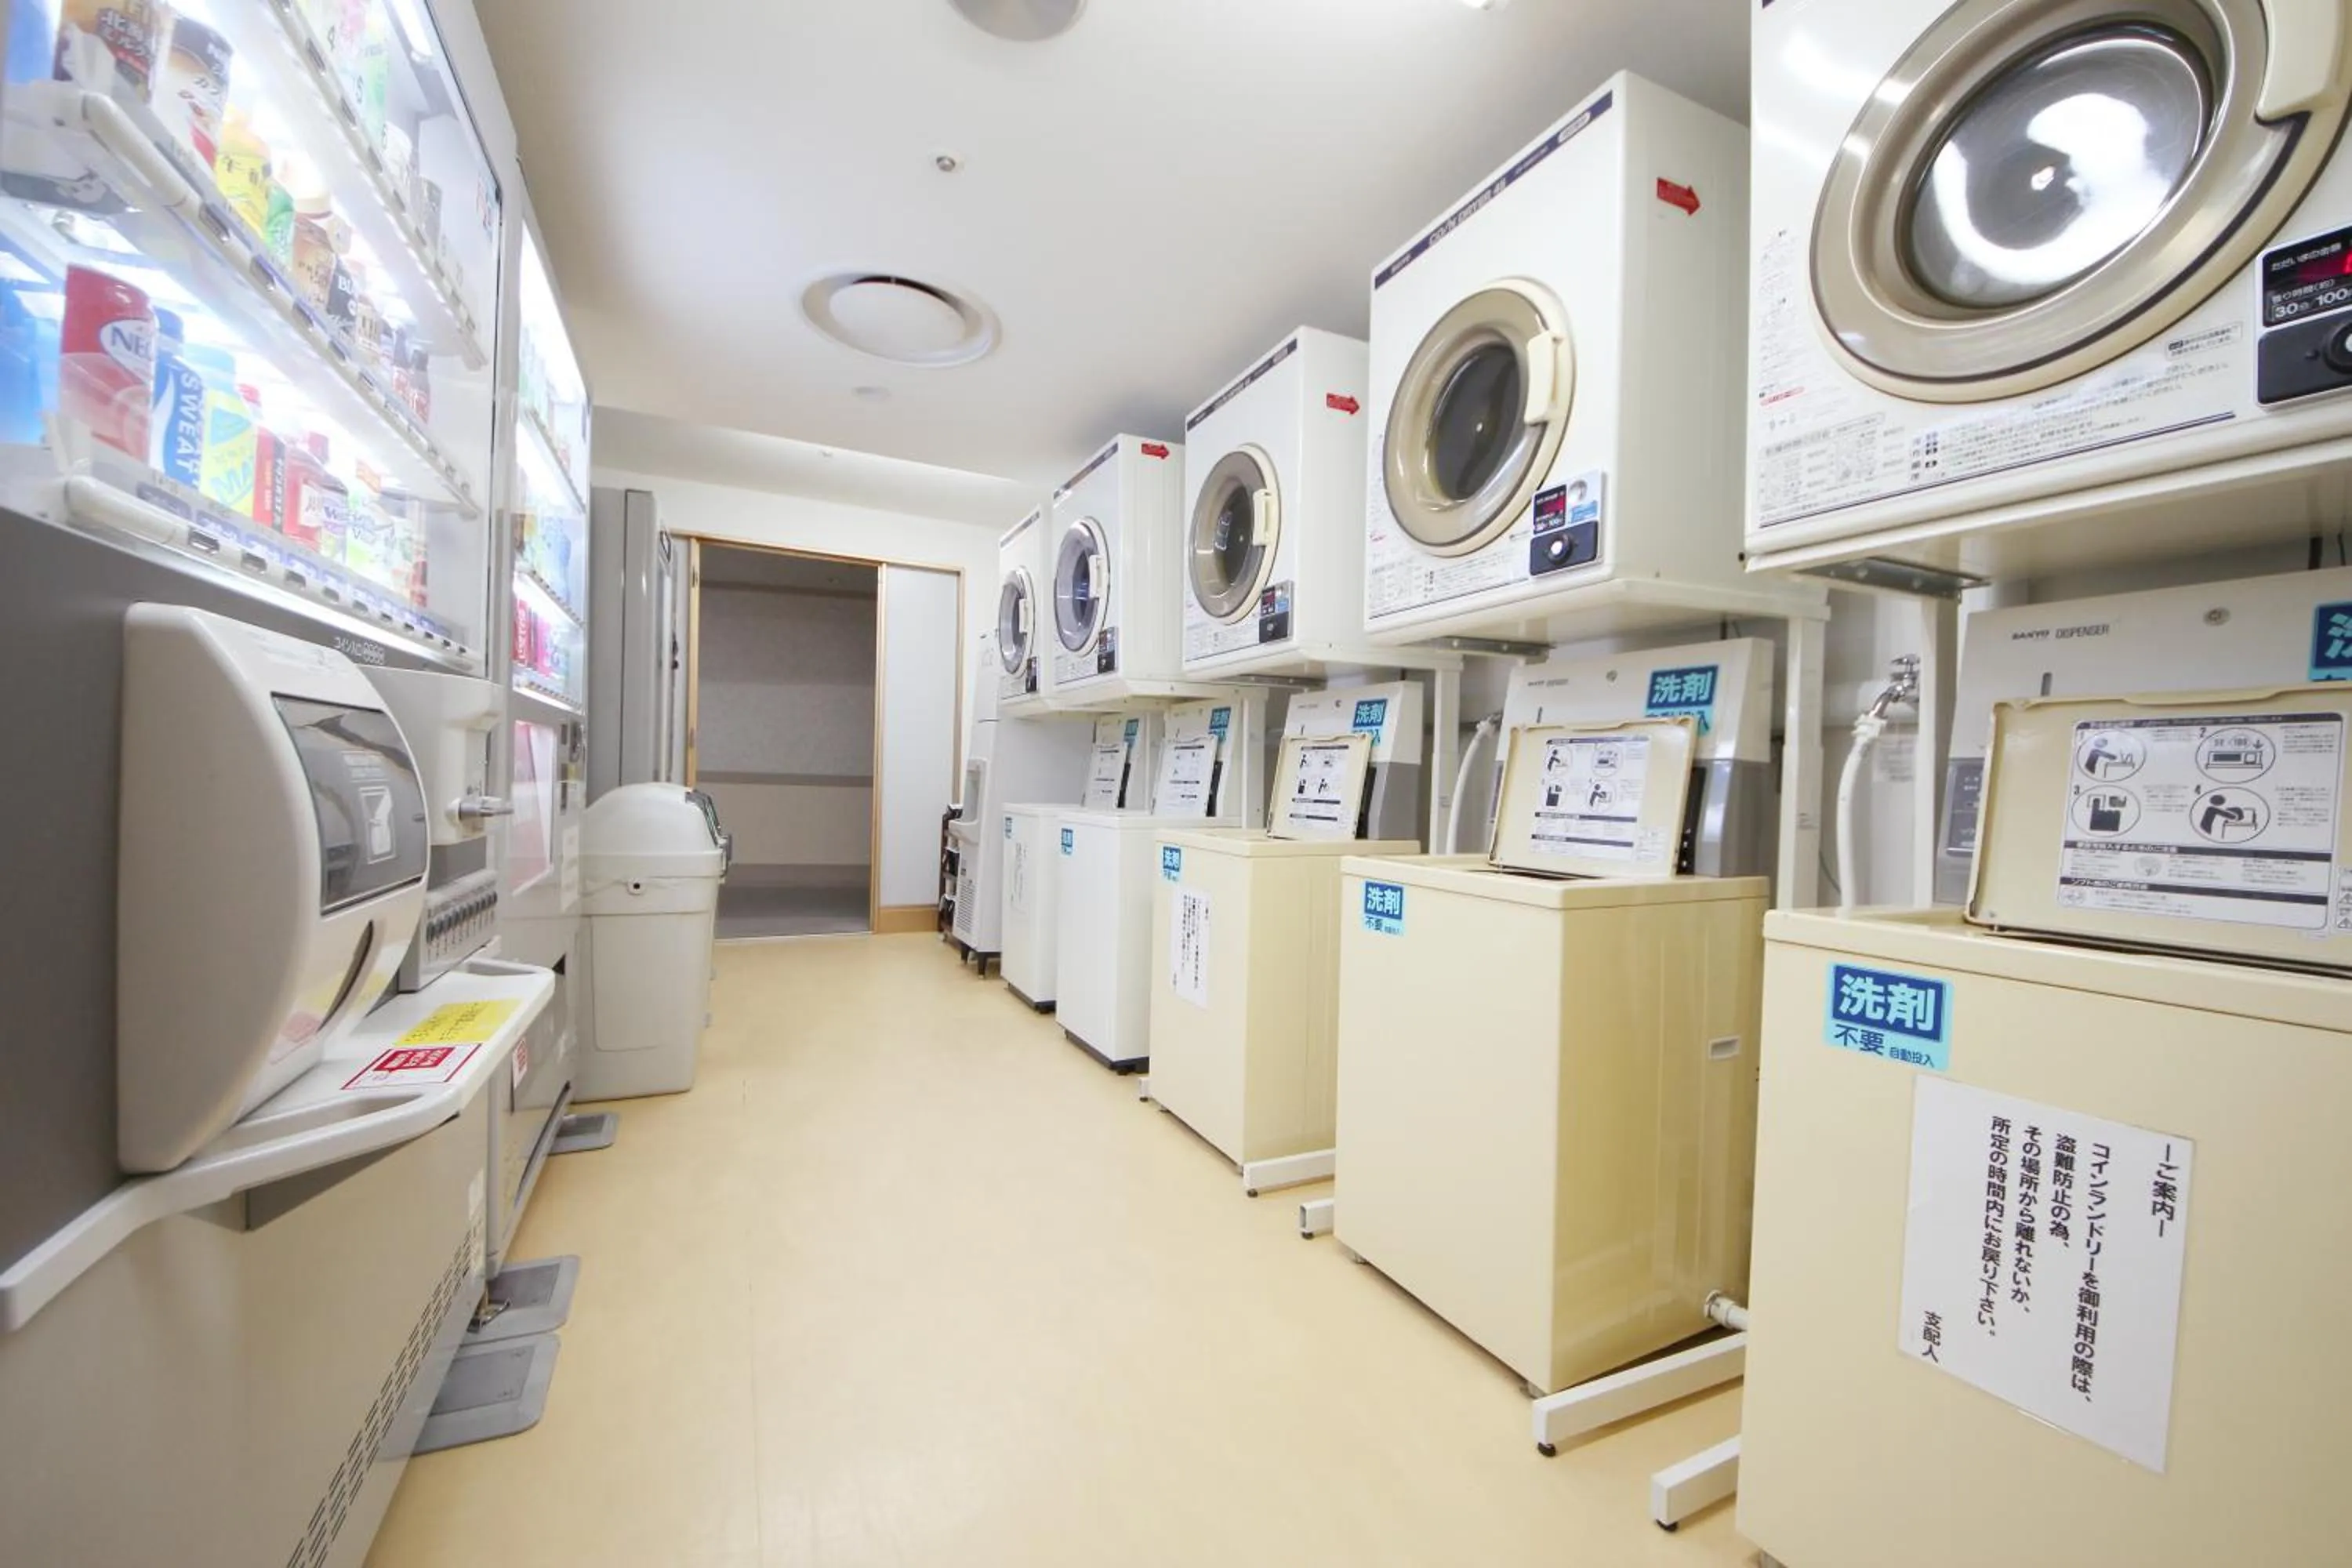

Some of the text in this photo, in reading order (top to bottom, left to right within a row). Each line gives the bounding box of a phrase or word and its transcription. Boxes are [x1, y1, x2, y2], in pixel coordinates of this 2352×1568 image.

[176, 371, 201, 474] SWEAT
[2055, 624, 2110, 639] DISPENSER
[1652, 671, 1712, 703] 洗剤
[1367, 885, 1401, 915] 洗剤
[1839, 974, 1936, 1031] 洗剤
[1834, 1023, 1935, 1068] 不要 自動投入
[2009, 1125, 2042, 1314] その場所から離れないか、
[2049, 1133, 2078, 1249] 盗難防止の為、
[1977, 1116, 2012, 1337] 所定の時間内にお戻り下さい。
[2071, 1142, 2111, 1403] コインランドリーを御利用の際は、
[1922, 1310, 1943, 1363] 支配人
